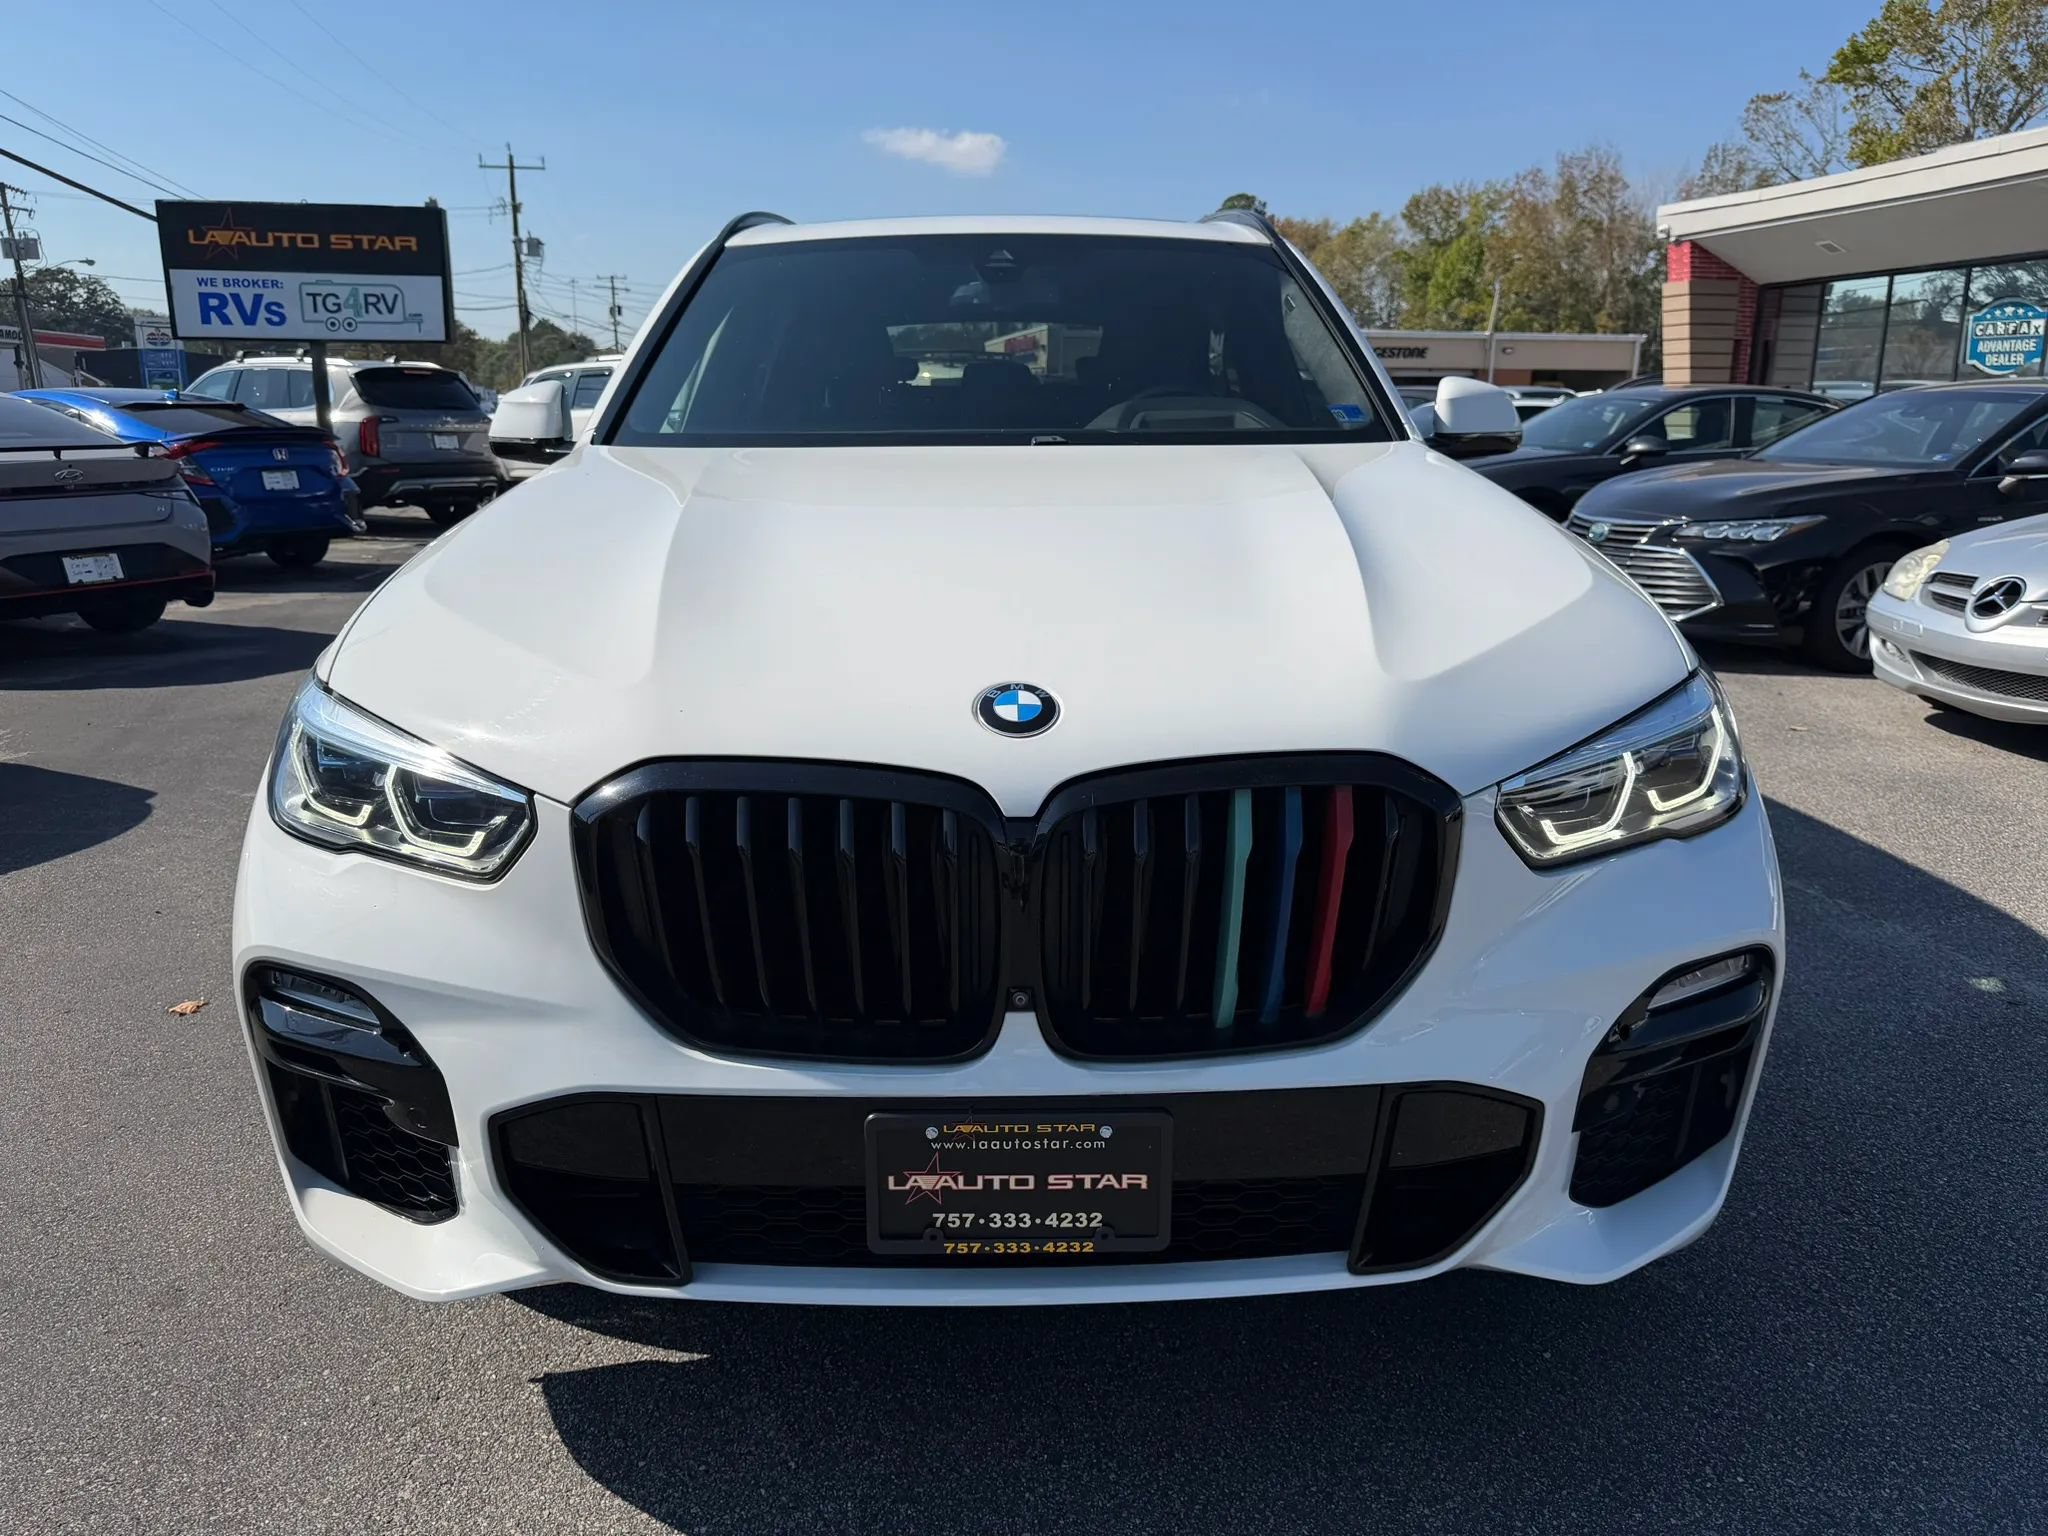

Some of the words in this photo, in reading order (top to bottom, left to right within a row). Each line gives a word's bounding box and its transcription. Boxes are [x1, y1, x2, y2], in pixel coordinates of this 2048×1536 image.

[330, 234, 418, 251] STAR
[196, 277, 217, 288] WE
[222, 277, 284, 290] BROKER:
[198, 292, 287, 327] RVs
[306, 287, 399, 318] TG4RV
[1975, 322, 2042, 336] CARFAX
[1977, 339, 2036, 352] ADVANTAGE
[1985, 353, 2025, 366] DEALER
[986, 683, 1050, 698] BMW
[1036, 1124, 1096, 1133] STAR
[930, 1138, 1106, 1150] www.laautostar.com
[1047, 1174, 1149, 1190] STAR
